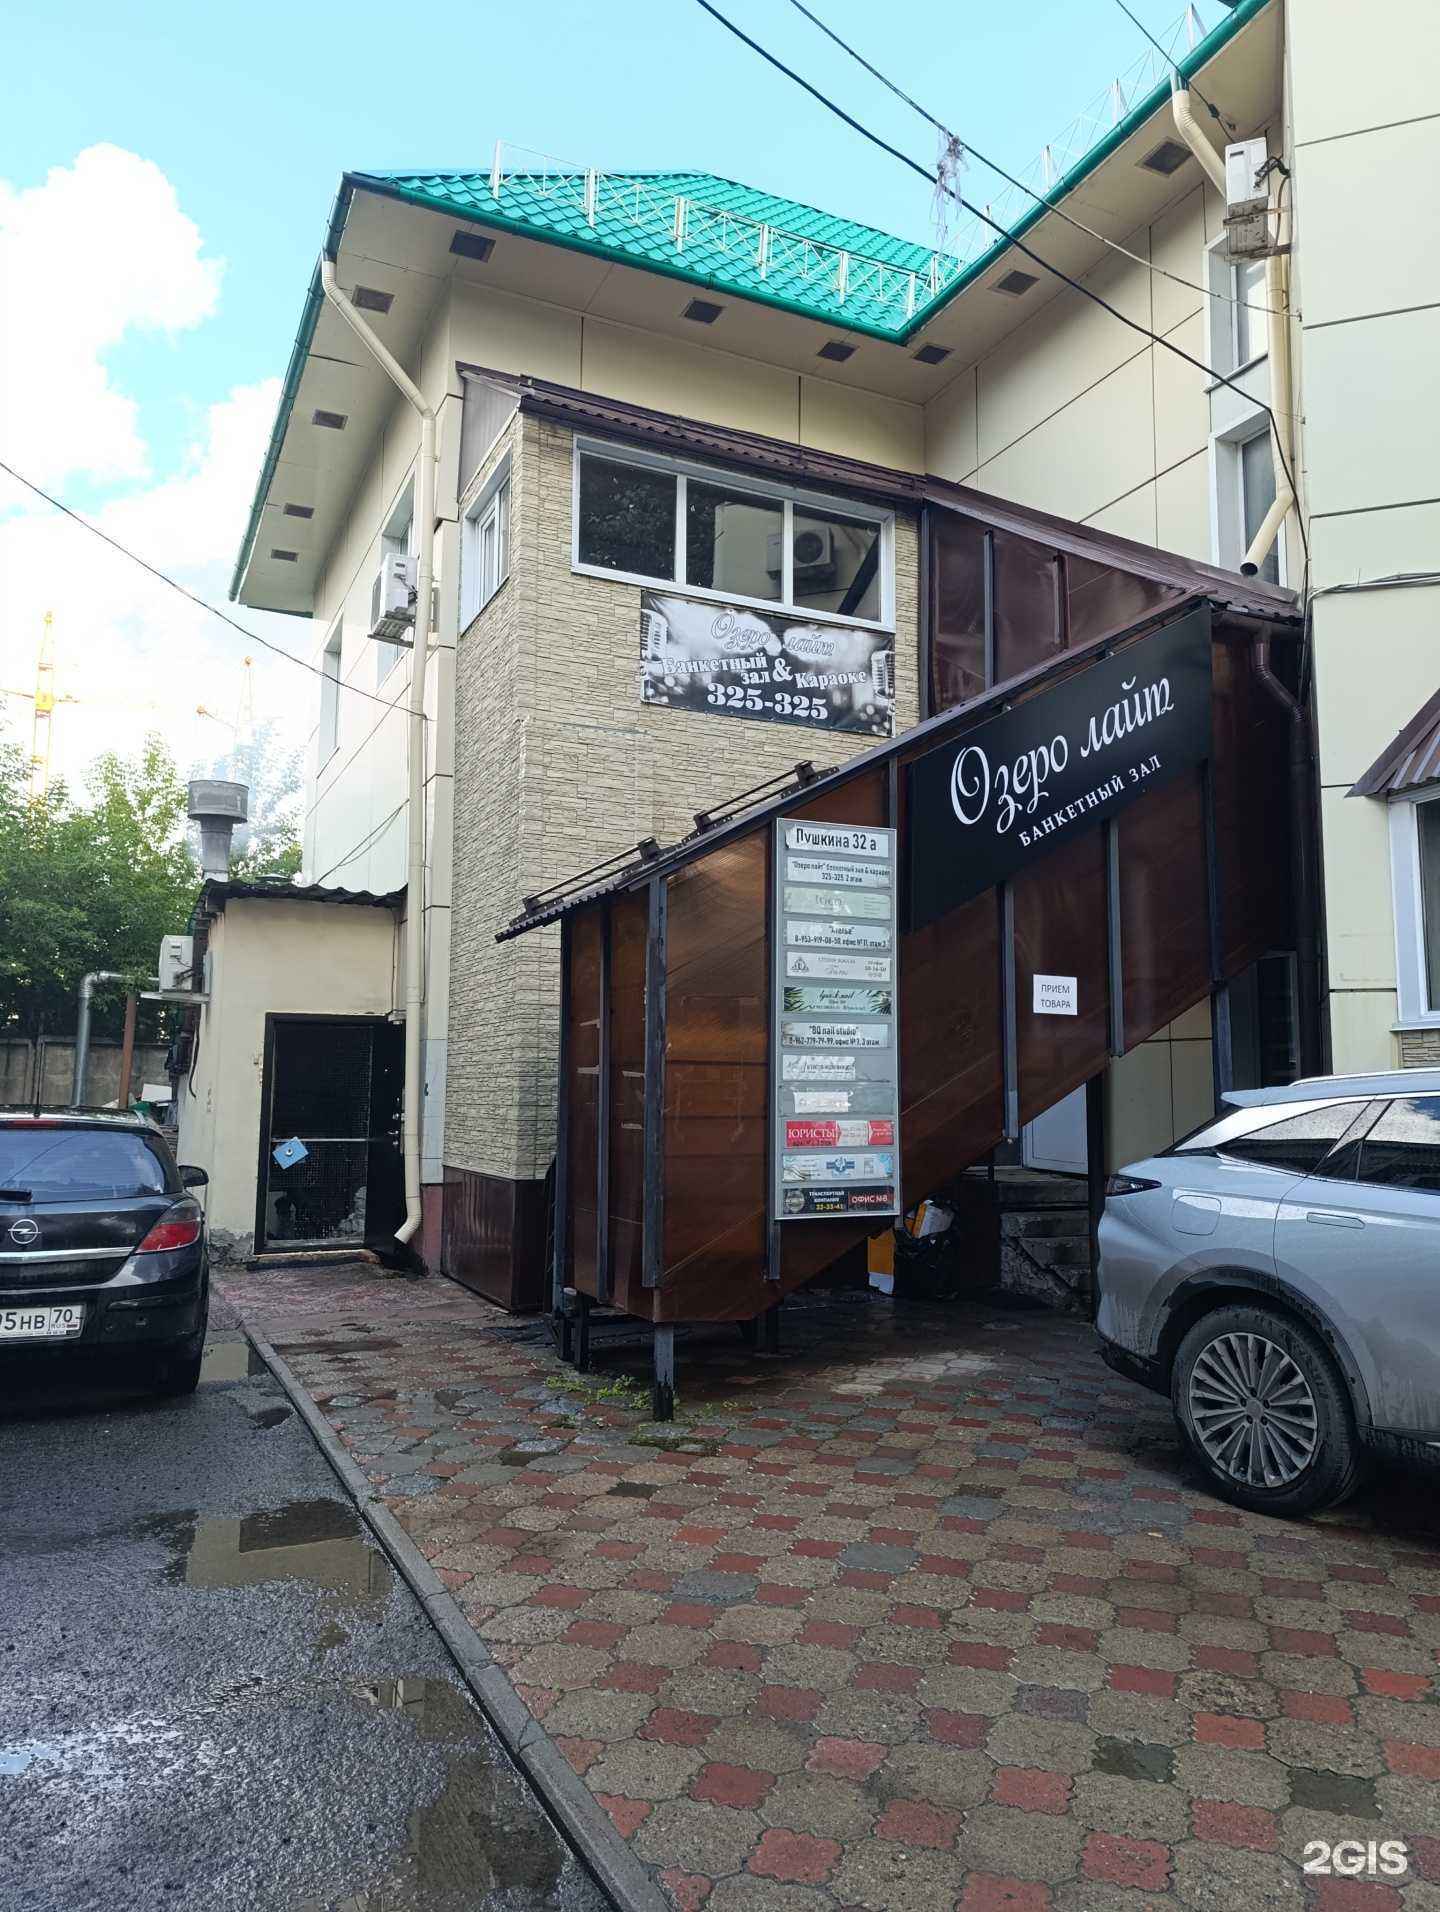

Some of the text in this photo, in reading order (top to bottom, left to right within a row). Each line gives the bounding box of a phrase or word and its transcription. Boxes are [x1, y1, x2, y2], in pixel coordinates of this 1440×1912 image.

[710, 611, 835, 657] Озеро лайт
[661, 652, 768, 674] Банкетный
[772, 658, 794, 682] &
[740, 670, 771, 686] зал
[794, 671, 868, 690] Караоке
[706, 682, 829, 720] 325-325
[950, 676, 1174, 834] Озеро лайт
[1018, 754, 1162, 847] БАНКЕТНЫЙ ЗАЛ
[796, 828, 877, 851] Пушкина 32 а
[1041, 983, 1071, 995] ПРИЕМ
[1040, 999, 1071, 1009] ТОВАРА
[788, 1128, 835, 1139] ЮРИСТЫ
[852, 1195, 875, 1205] ОФИС
[53, 1309, 73, 1324] 70
